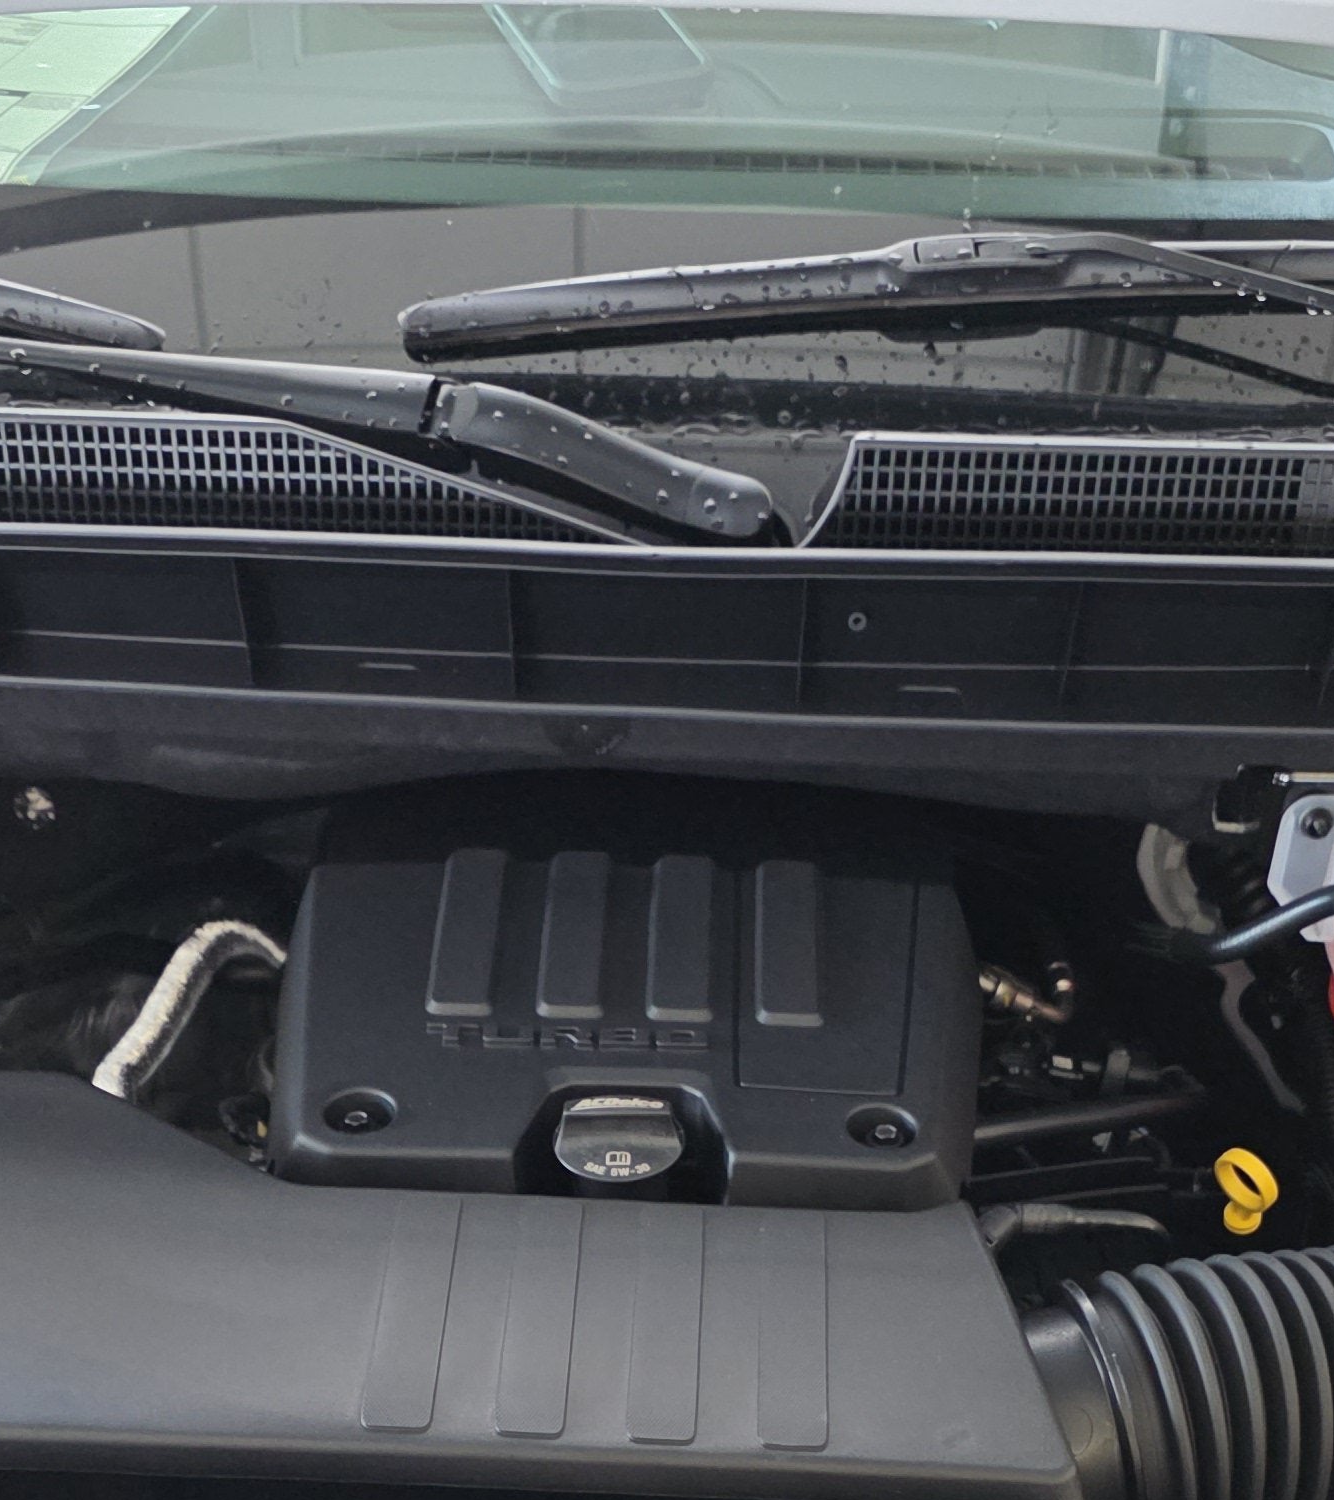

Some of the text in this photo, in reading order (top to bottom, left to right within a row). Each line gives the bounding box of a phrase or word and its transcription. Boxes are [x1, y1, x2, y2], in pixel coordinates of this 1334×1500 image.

[425, 1022, 709, 1050] TURBO
[571, 1097, 664, 1111] ACDelco
[584, 1162, 607, 1175] SAE
